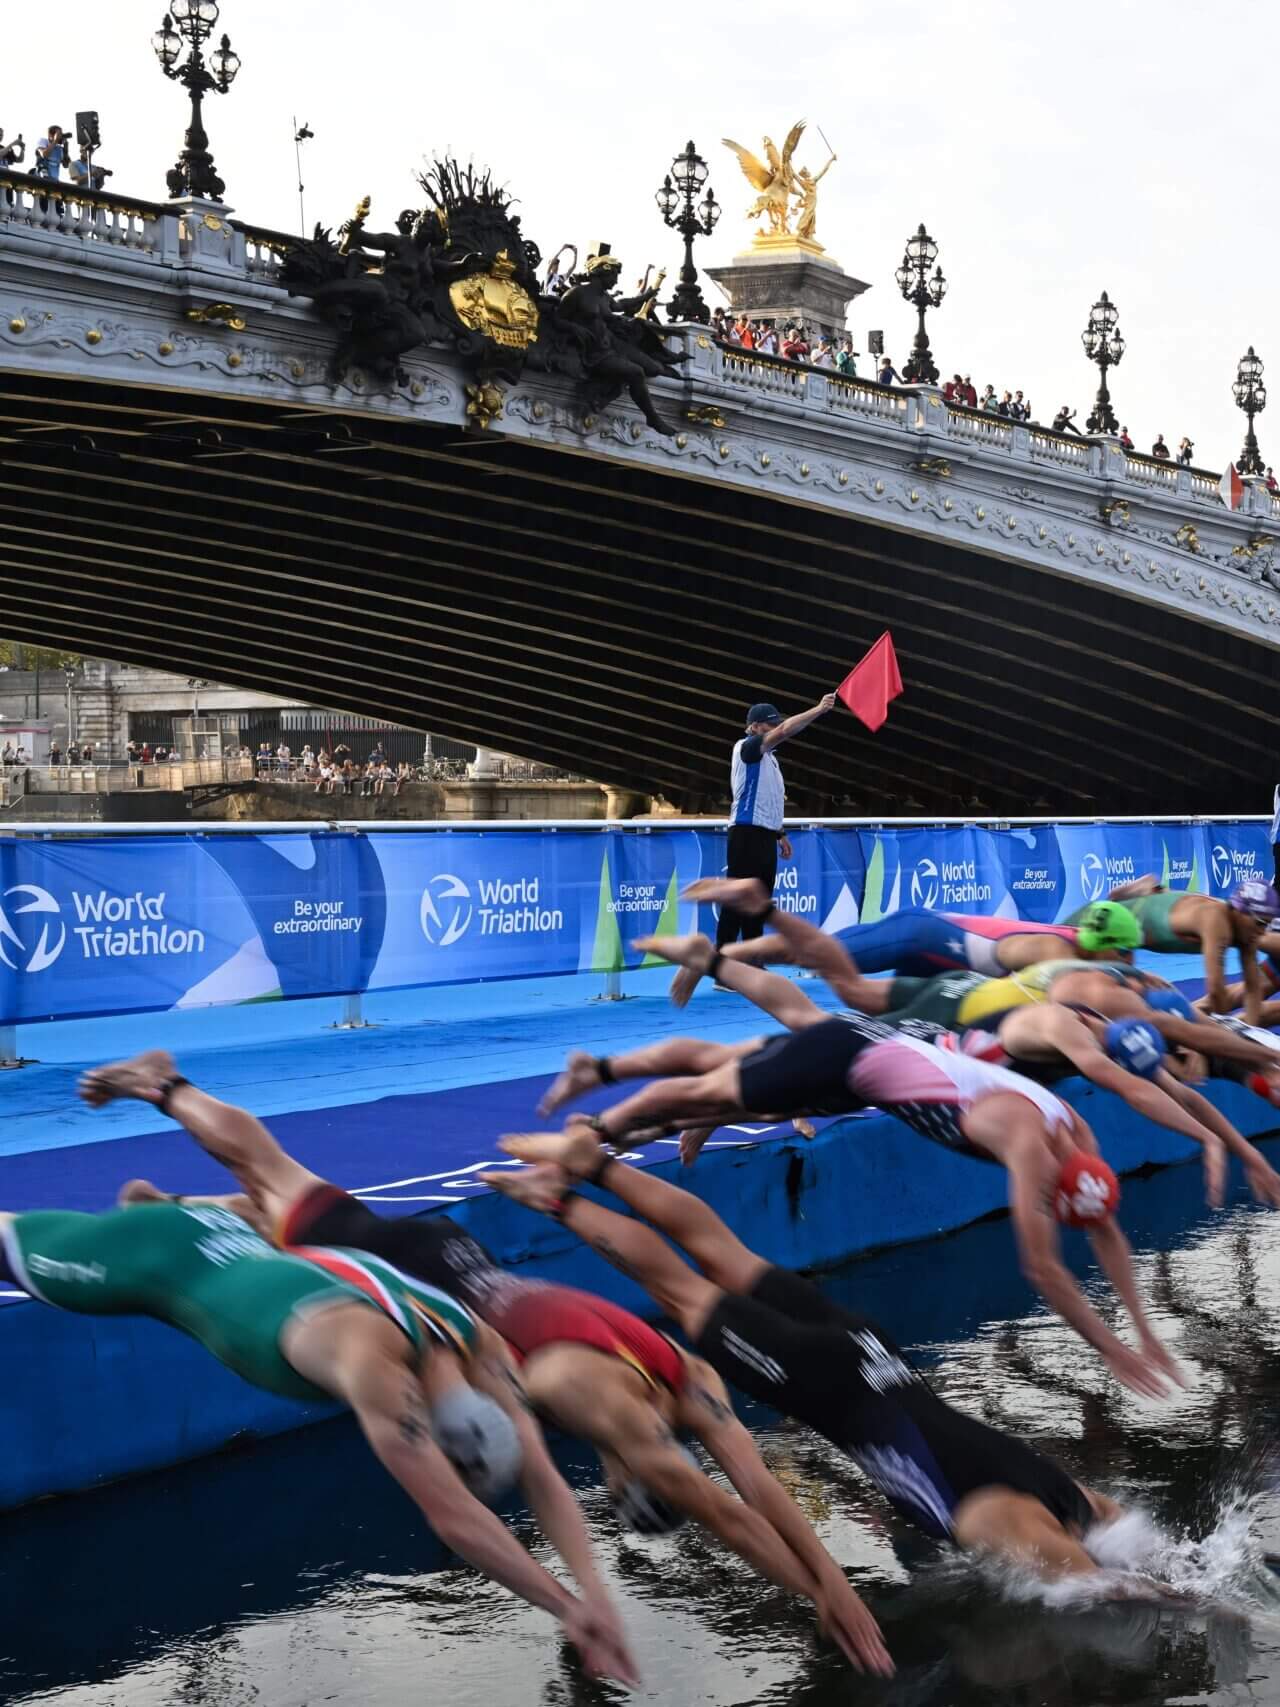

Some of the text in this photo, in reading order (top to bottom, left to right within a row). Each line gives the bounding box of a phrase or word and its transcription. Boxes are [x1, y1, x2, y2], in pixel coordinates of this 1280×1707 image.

[942, 860, 975, 881] World
[1105, 856, 1134, 874] World
[1232, 867, 1264, 882] Trialon
[774, 866, 797, 889] rld
[1013, 879, 1056, 890] extraordinary
[1024, 869, 1048, 881] Be your
[1107, 875, 1136, 894] Triathl
[478, 877, 538, 905] World
[620, 884, 656, 900] Be your
[942, 882, 991, 904] Triathlon
[72, 891, 165, 922] World
[294, 900, 344, 918] Be your
[606, 896, 669, 913] extraordinary
[771, 891, 816, 912] athlon
[274, 915, 363, 934] extraordinary
[478, 907, 563, 935] Triathlon
[74, 924, 204, 958] Triathlon
